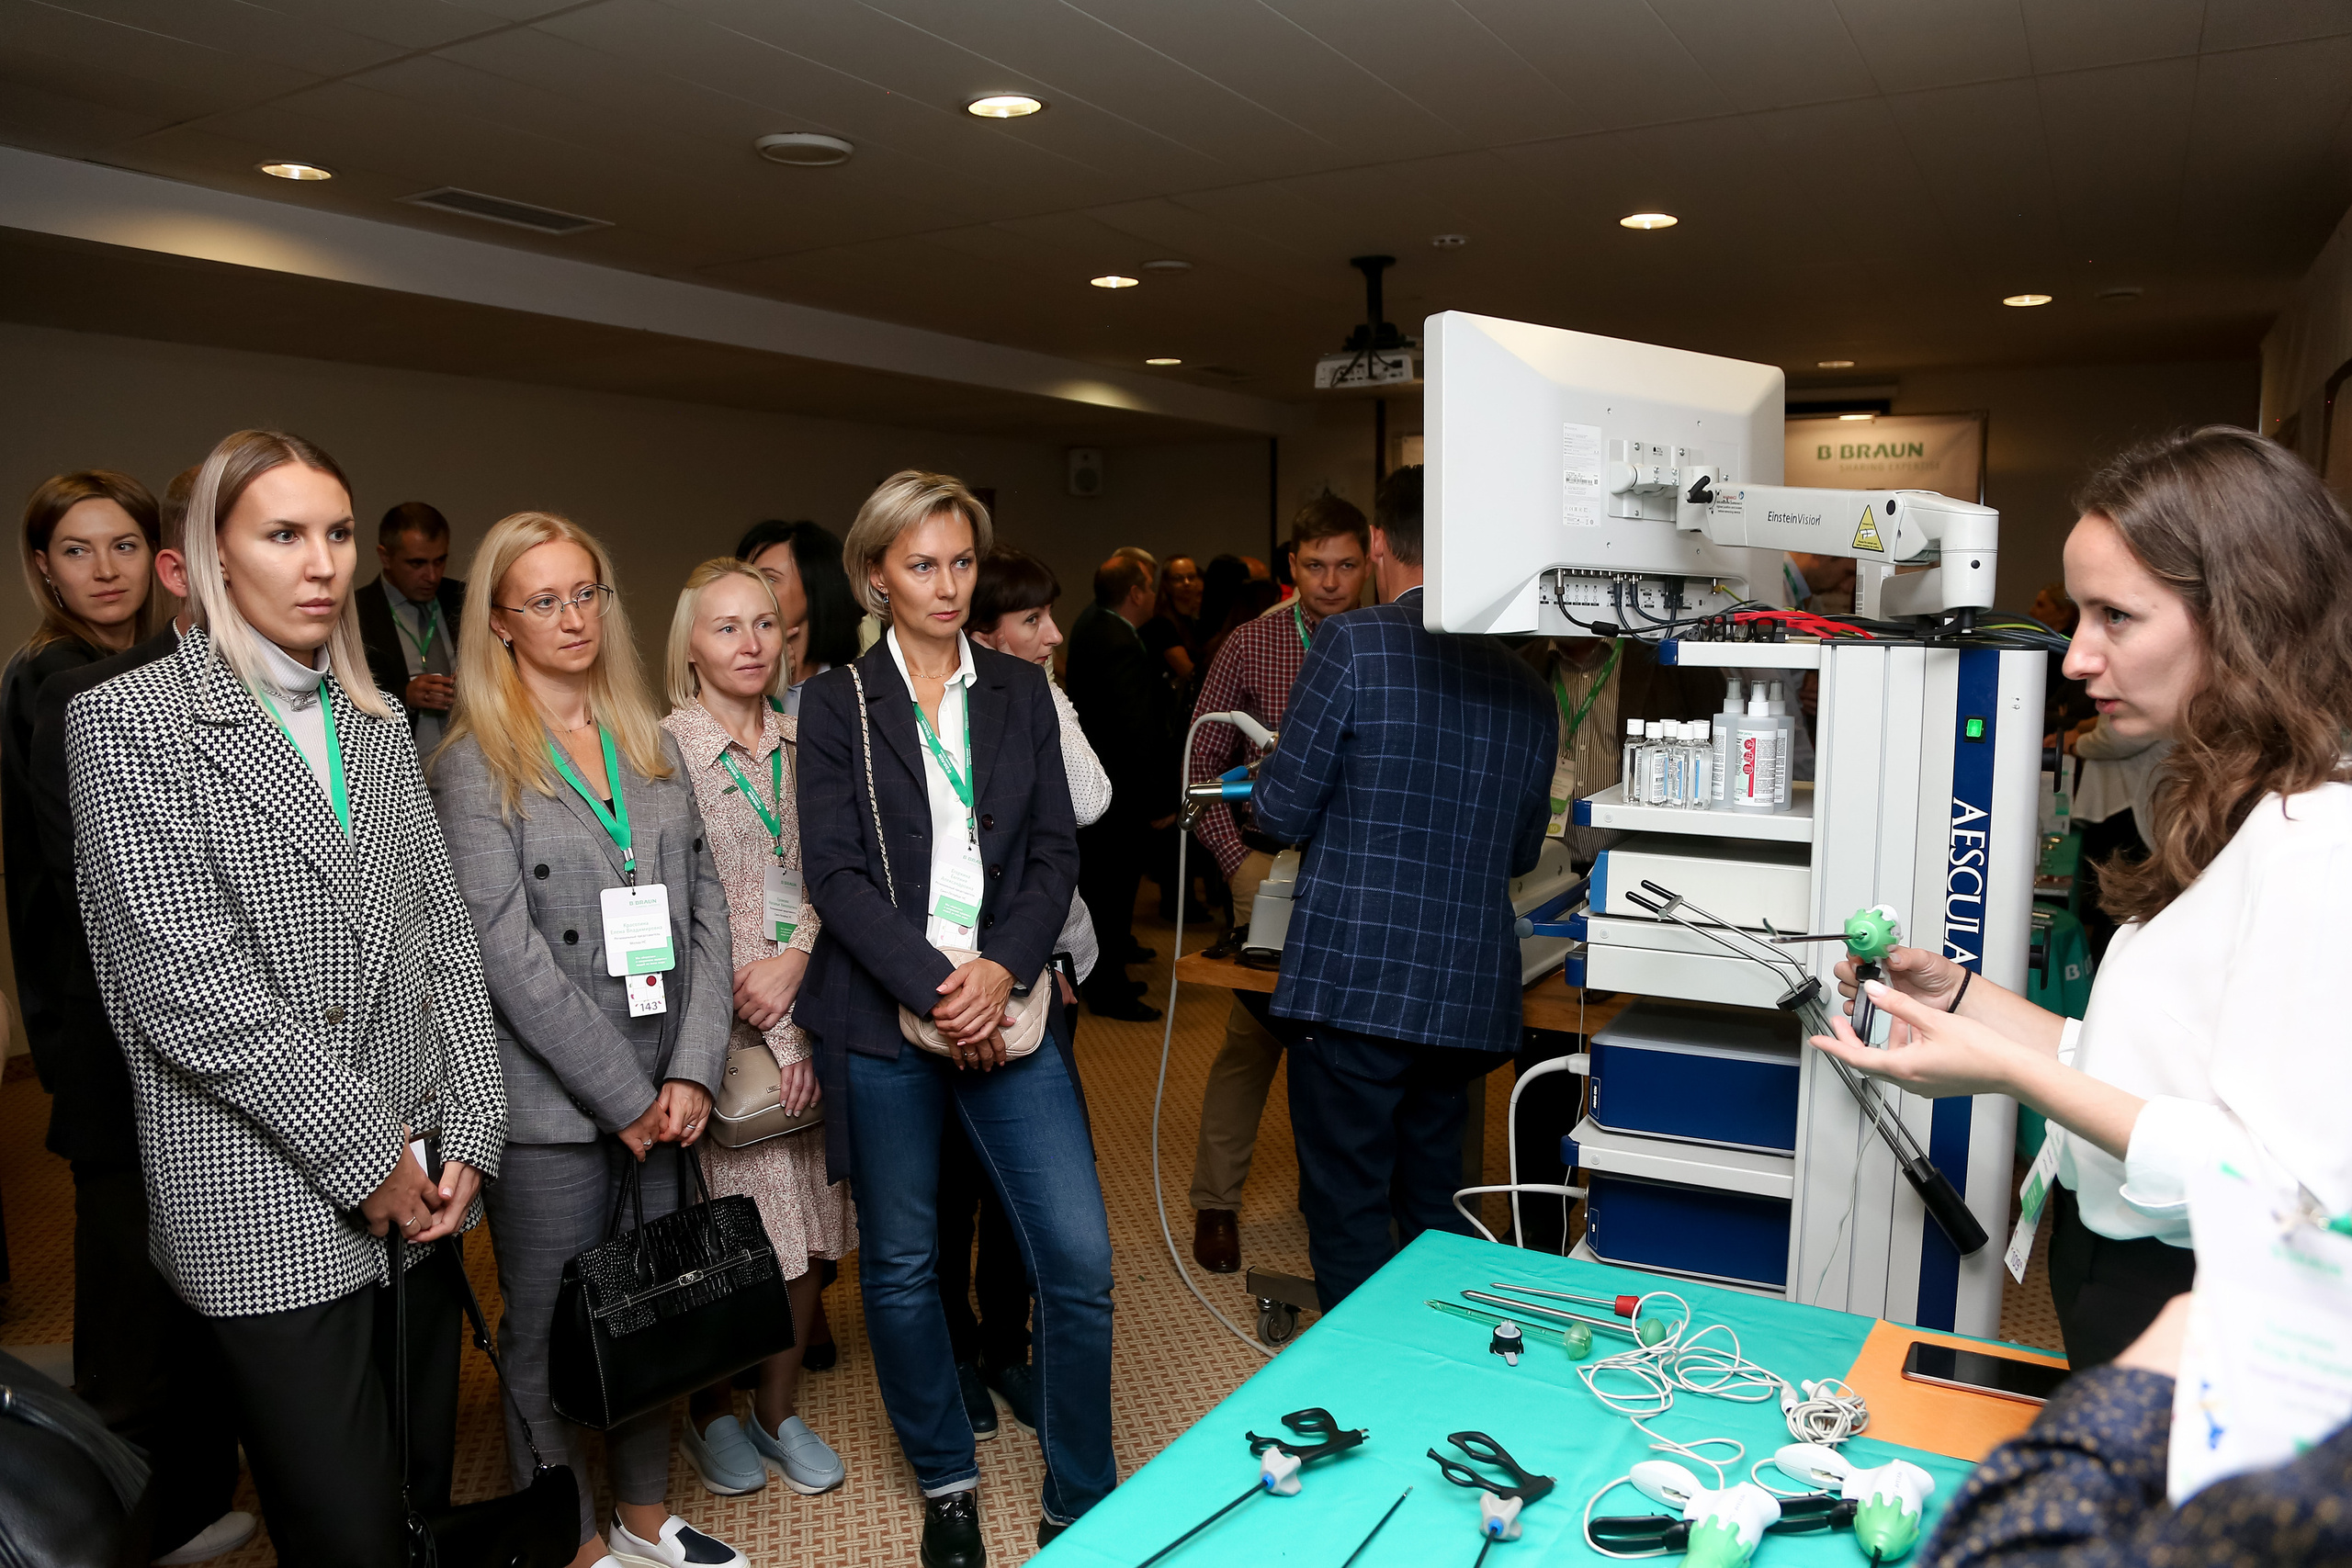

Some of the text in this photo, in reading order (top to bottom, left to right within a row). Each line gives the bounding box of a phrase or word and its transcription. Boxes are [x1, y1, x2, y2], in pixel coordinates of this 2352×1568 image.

[1817, 442, 1924, 459] B BRAUN
[1768, 511, 1821, 525] EinsteinVision
[1943, 796, 1989, 964] AESCULA
[640, 1001, 658, 1011] 143
[2010, 1251, 2020, 1271] 109
